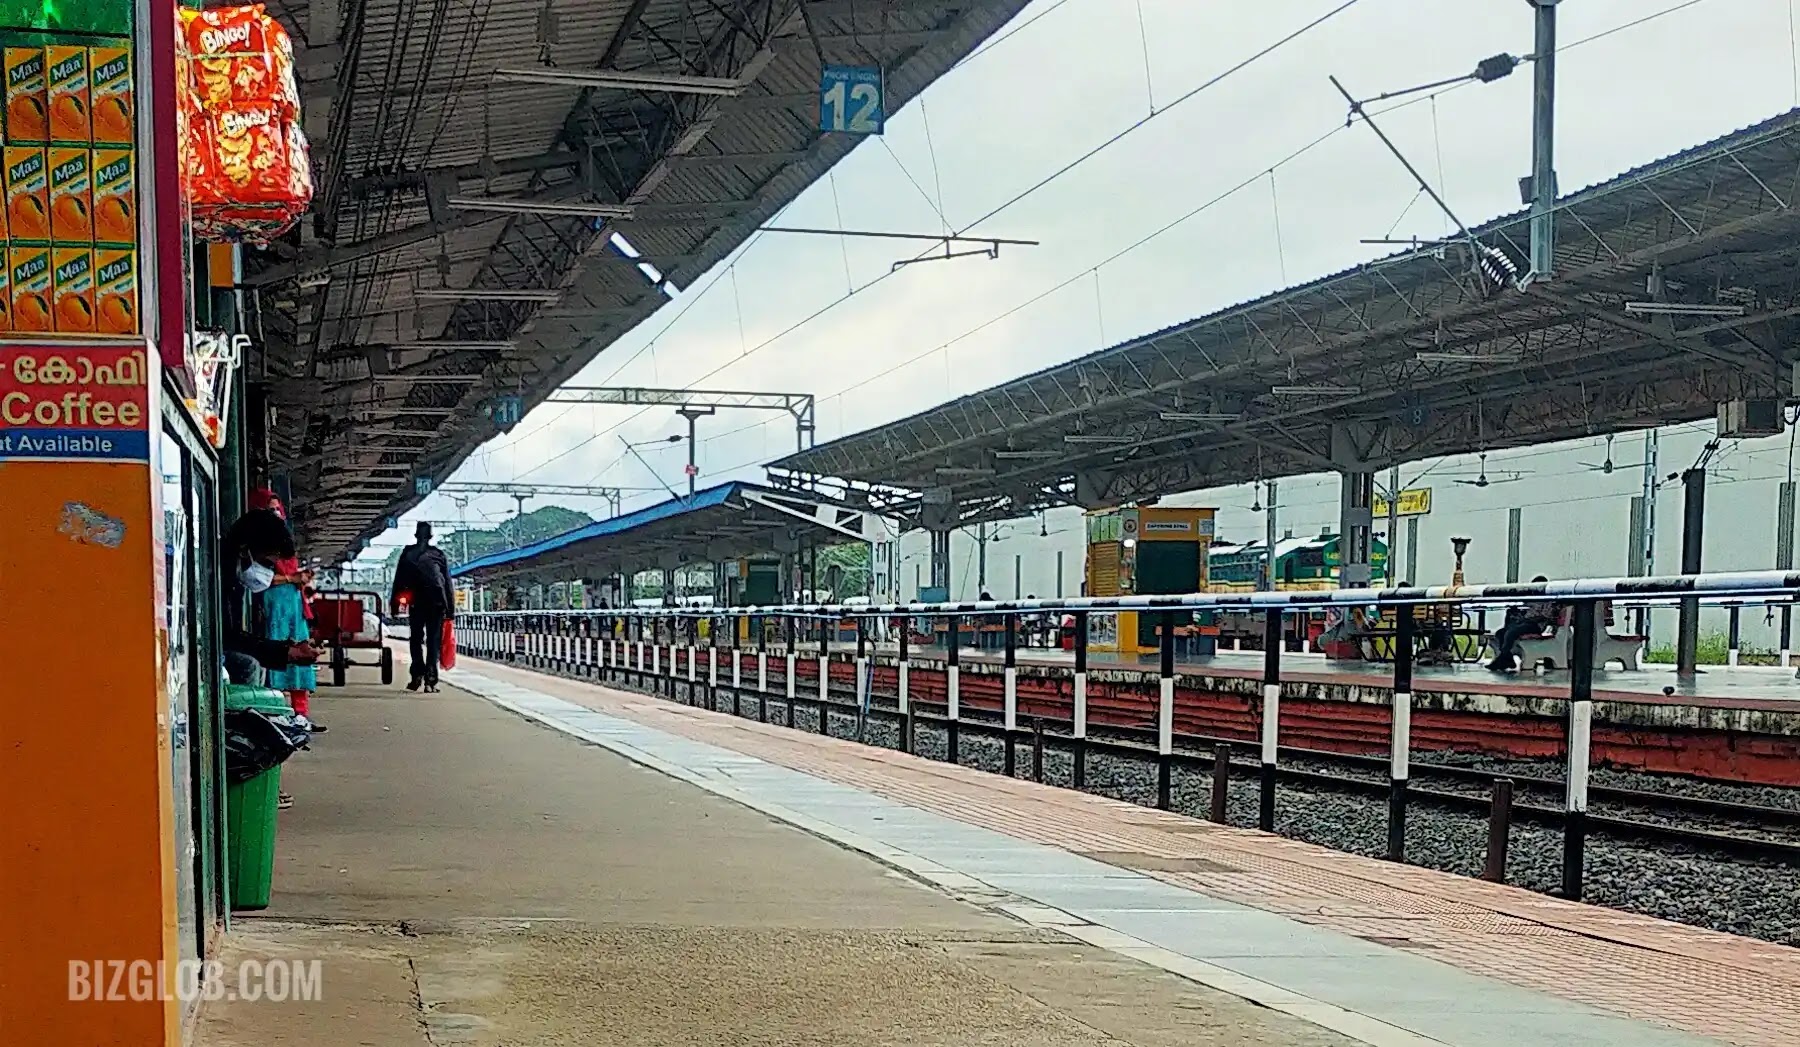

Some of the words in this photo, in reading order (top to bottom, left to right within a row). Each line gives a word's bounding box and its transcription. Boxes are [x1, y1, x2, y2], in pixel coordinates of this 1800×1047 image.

[200, 21, 251, 54] BINGO!
[10, 60, 40, 82] Maa
[51, 59, 81, 81] Maa
[95, 60, 125, 80] Maa
[823, 81, 880, 131] 12
[10, 157, 40, 181] Maa
[54, 159, 85, 181] Maa
[98, 162, 127, 183] Maa
[16, 259, 45, 281] Maa
[57, 259, 88, 281] Maa
[99, 261, 130, 282] Maa
[13, 349, 146, 386] കോഫി
[1, 391, 141, 426] Coffee
[17, 434, 113, 453] Available
